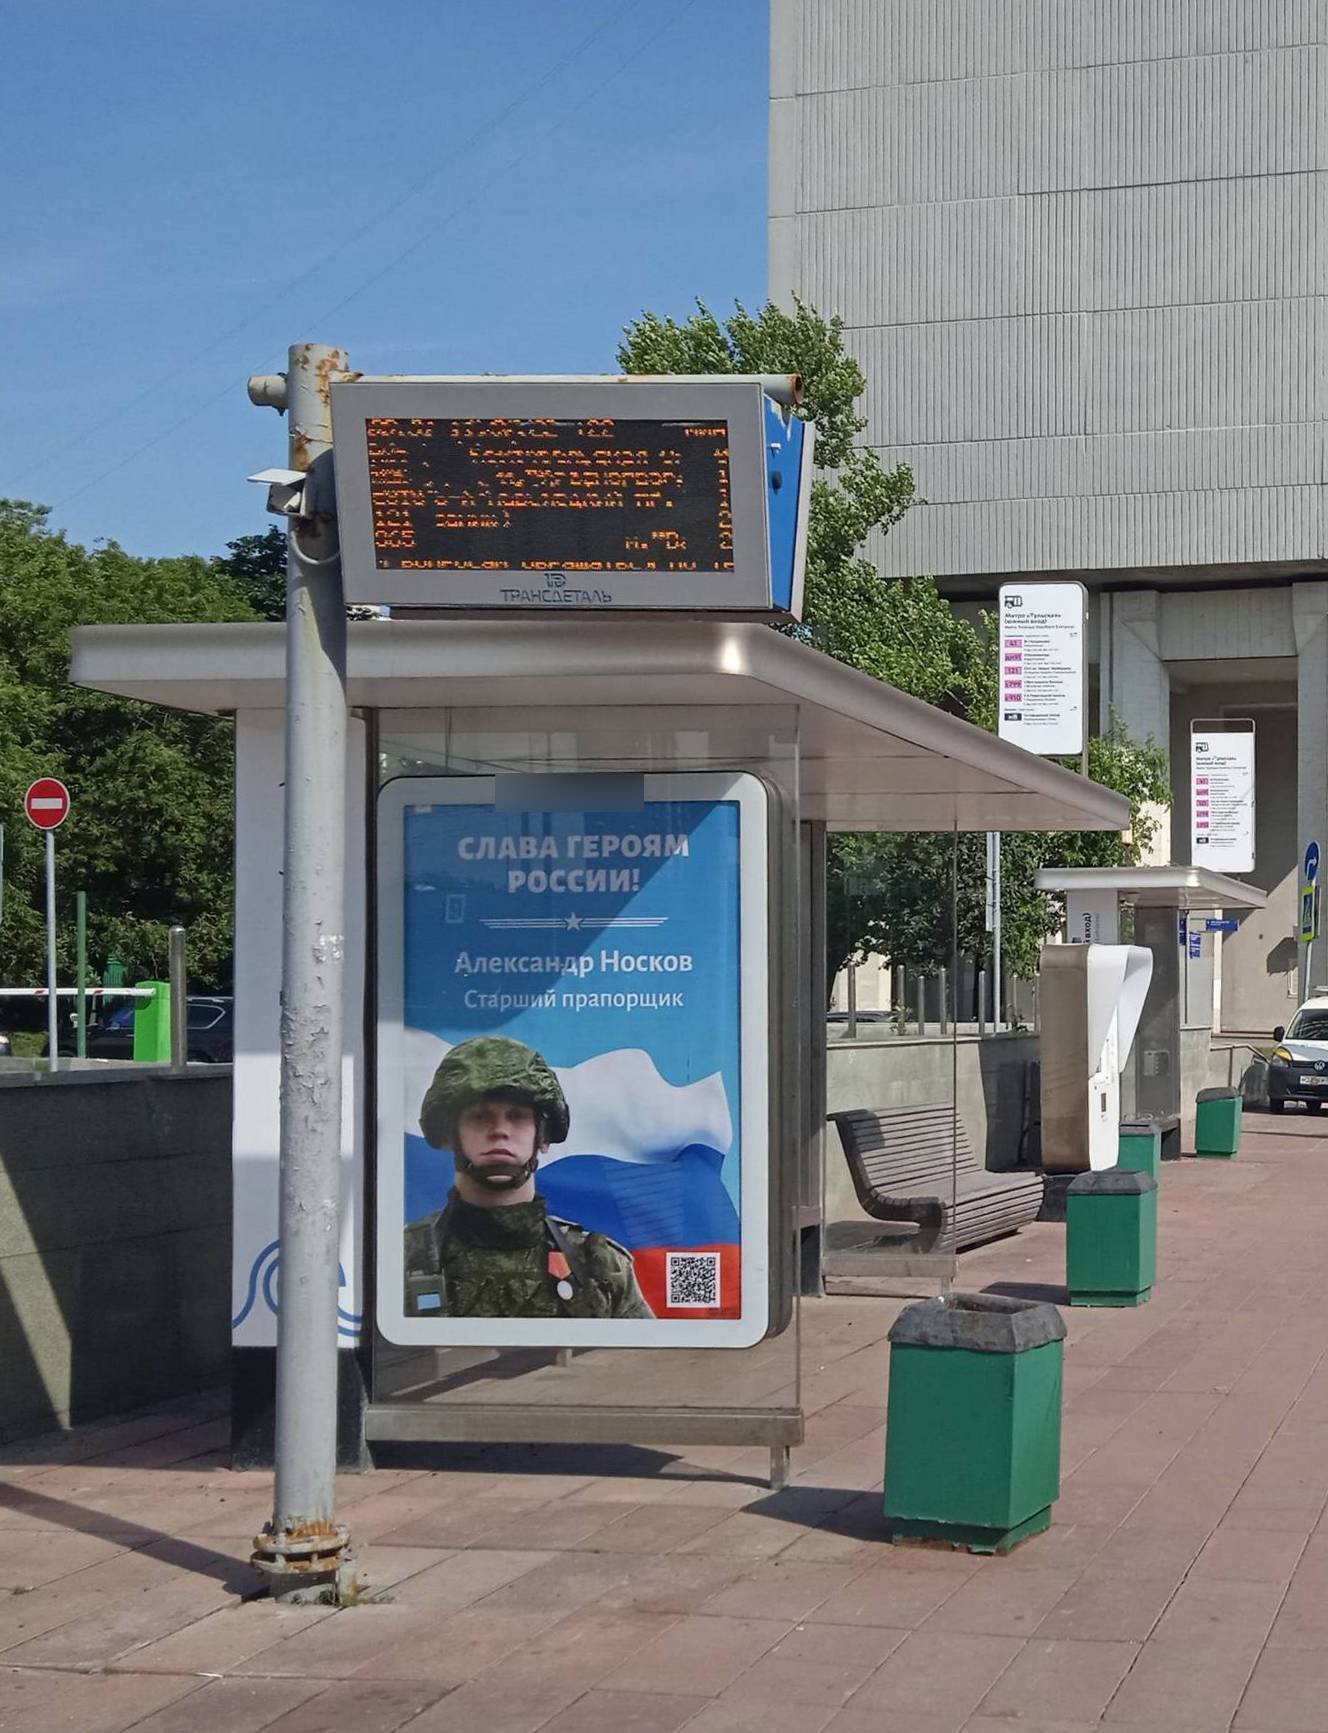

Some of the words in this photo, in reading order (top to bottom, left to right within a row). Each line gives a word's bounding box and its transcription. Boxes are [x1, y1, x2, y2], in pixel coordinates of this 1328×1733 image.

[500, 588, 612, 602] ТРАНСДЕТАЛЬ
[458, 835, 559, 860] СЛАВА
[567, 834, 689, 858] ГЕРОЯМ
[508, 868, 640, 893] РОССИИ!
[1082, 912, 1091, 939] вход)
[454, 951, 594, 977] Александр
[600, 950, 693, 972] Носков
[464, 989, 556, 1012] Старший
[562, 991, 684, 1012] прапорщик
